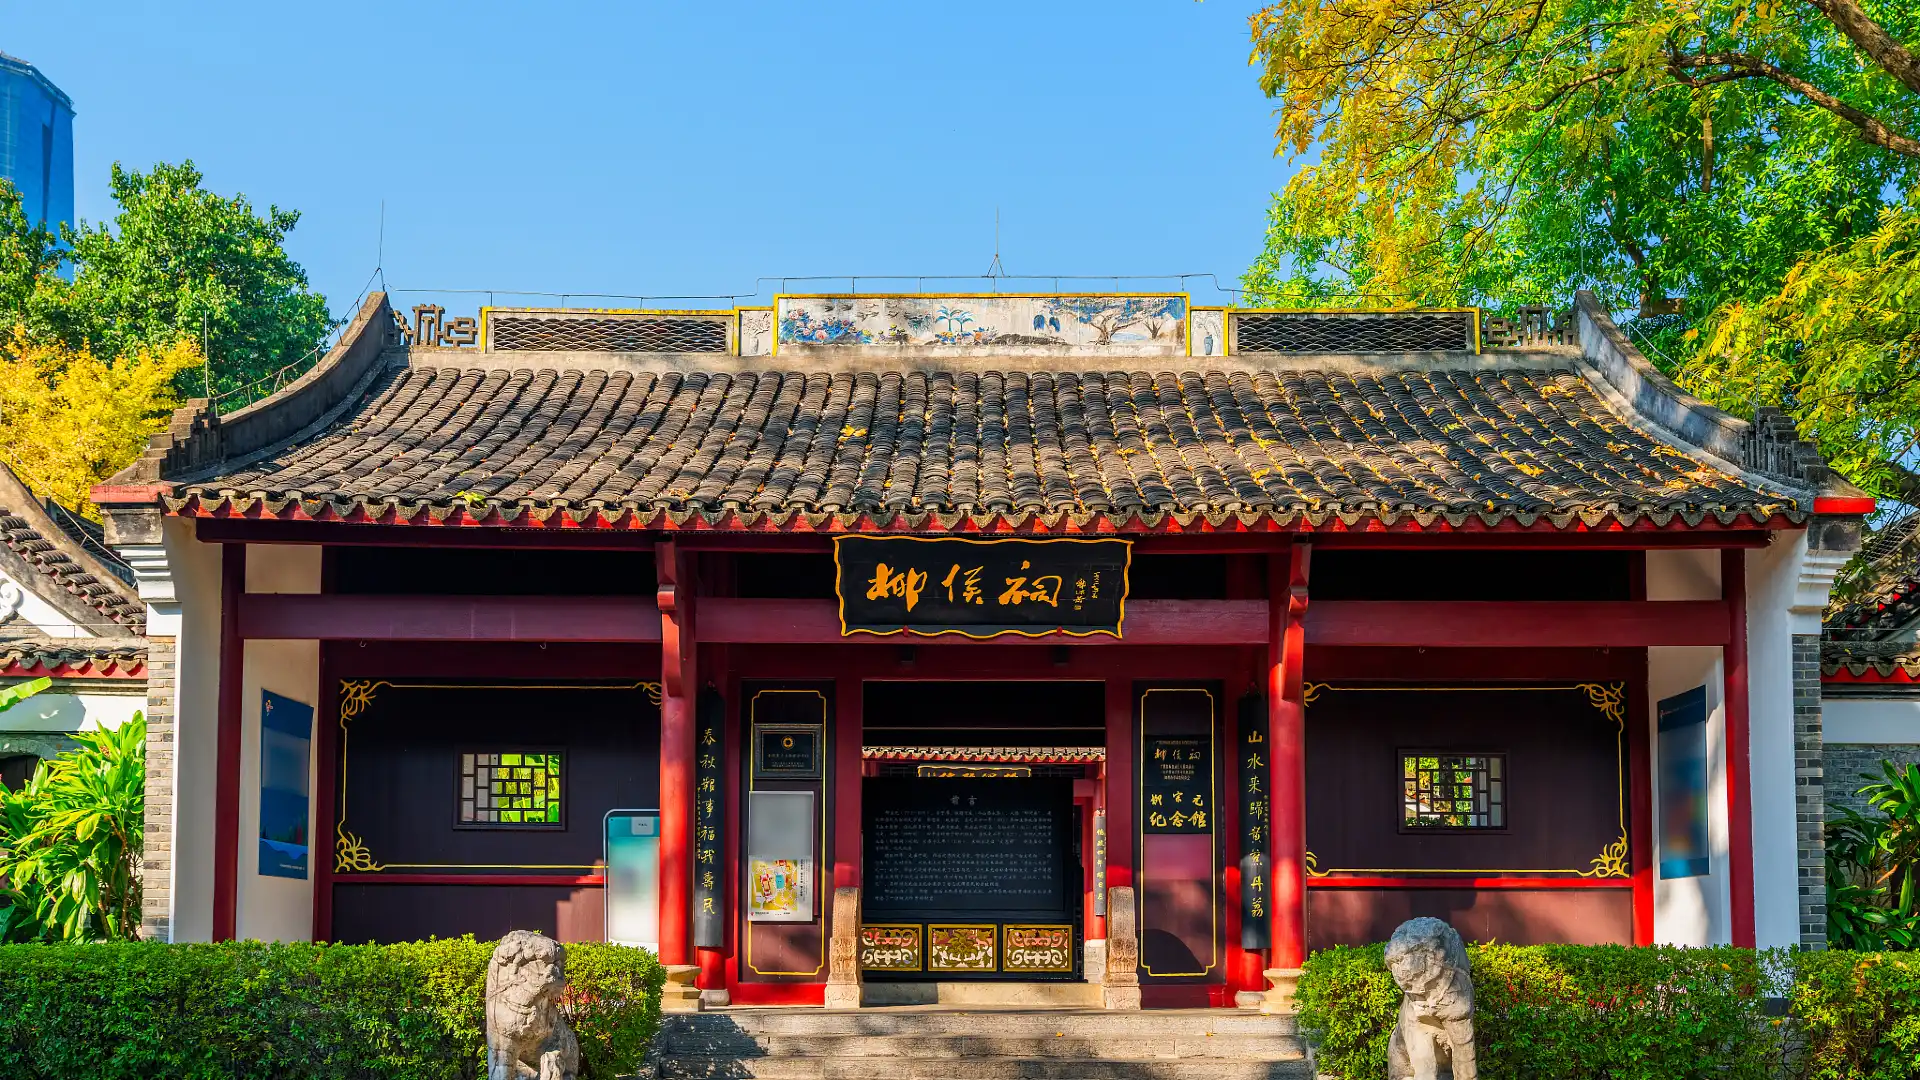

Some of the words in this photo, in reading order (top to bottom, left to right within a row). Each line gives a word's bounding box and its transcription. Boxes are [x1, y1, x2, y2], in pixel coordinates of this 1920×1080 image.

[867, 560, 1062, 612] 柳侯祠
[1150, 790, 1204, 807] 柳宗元
[1149, 810, 1207, 829] 纪念馆
